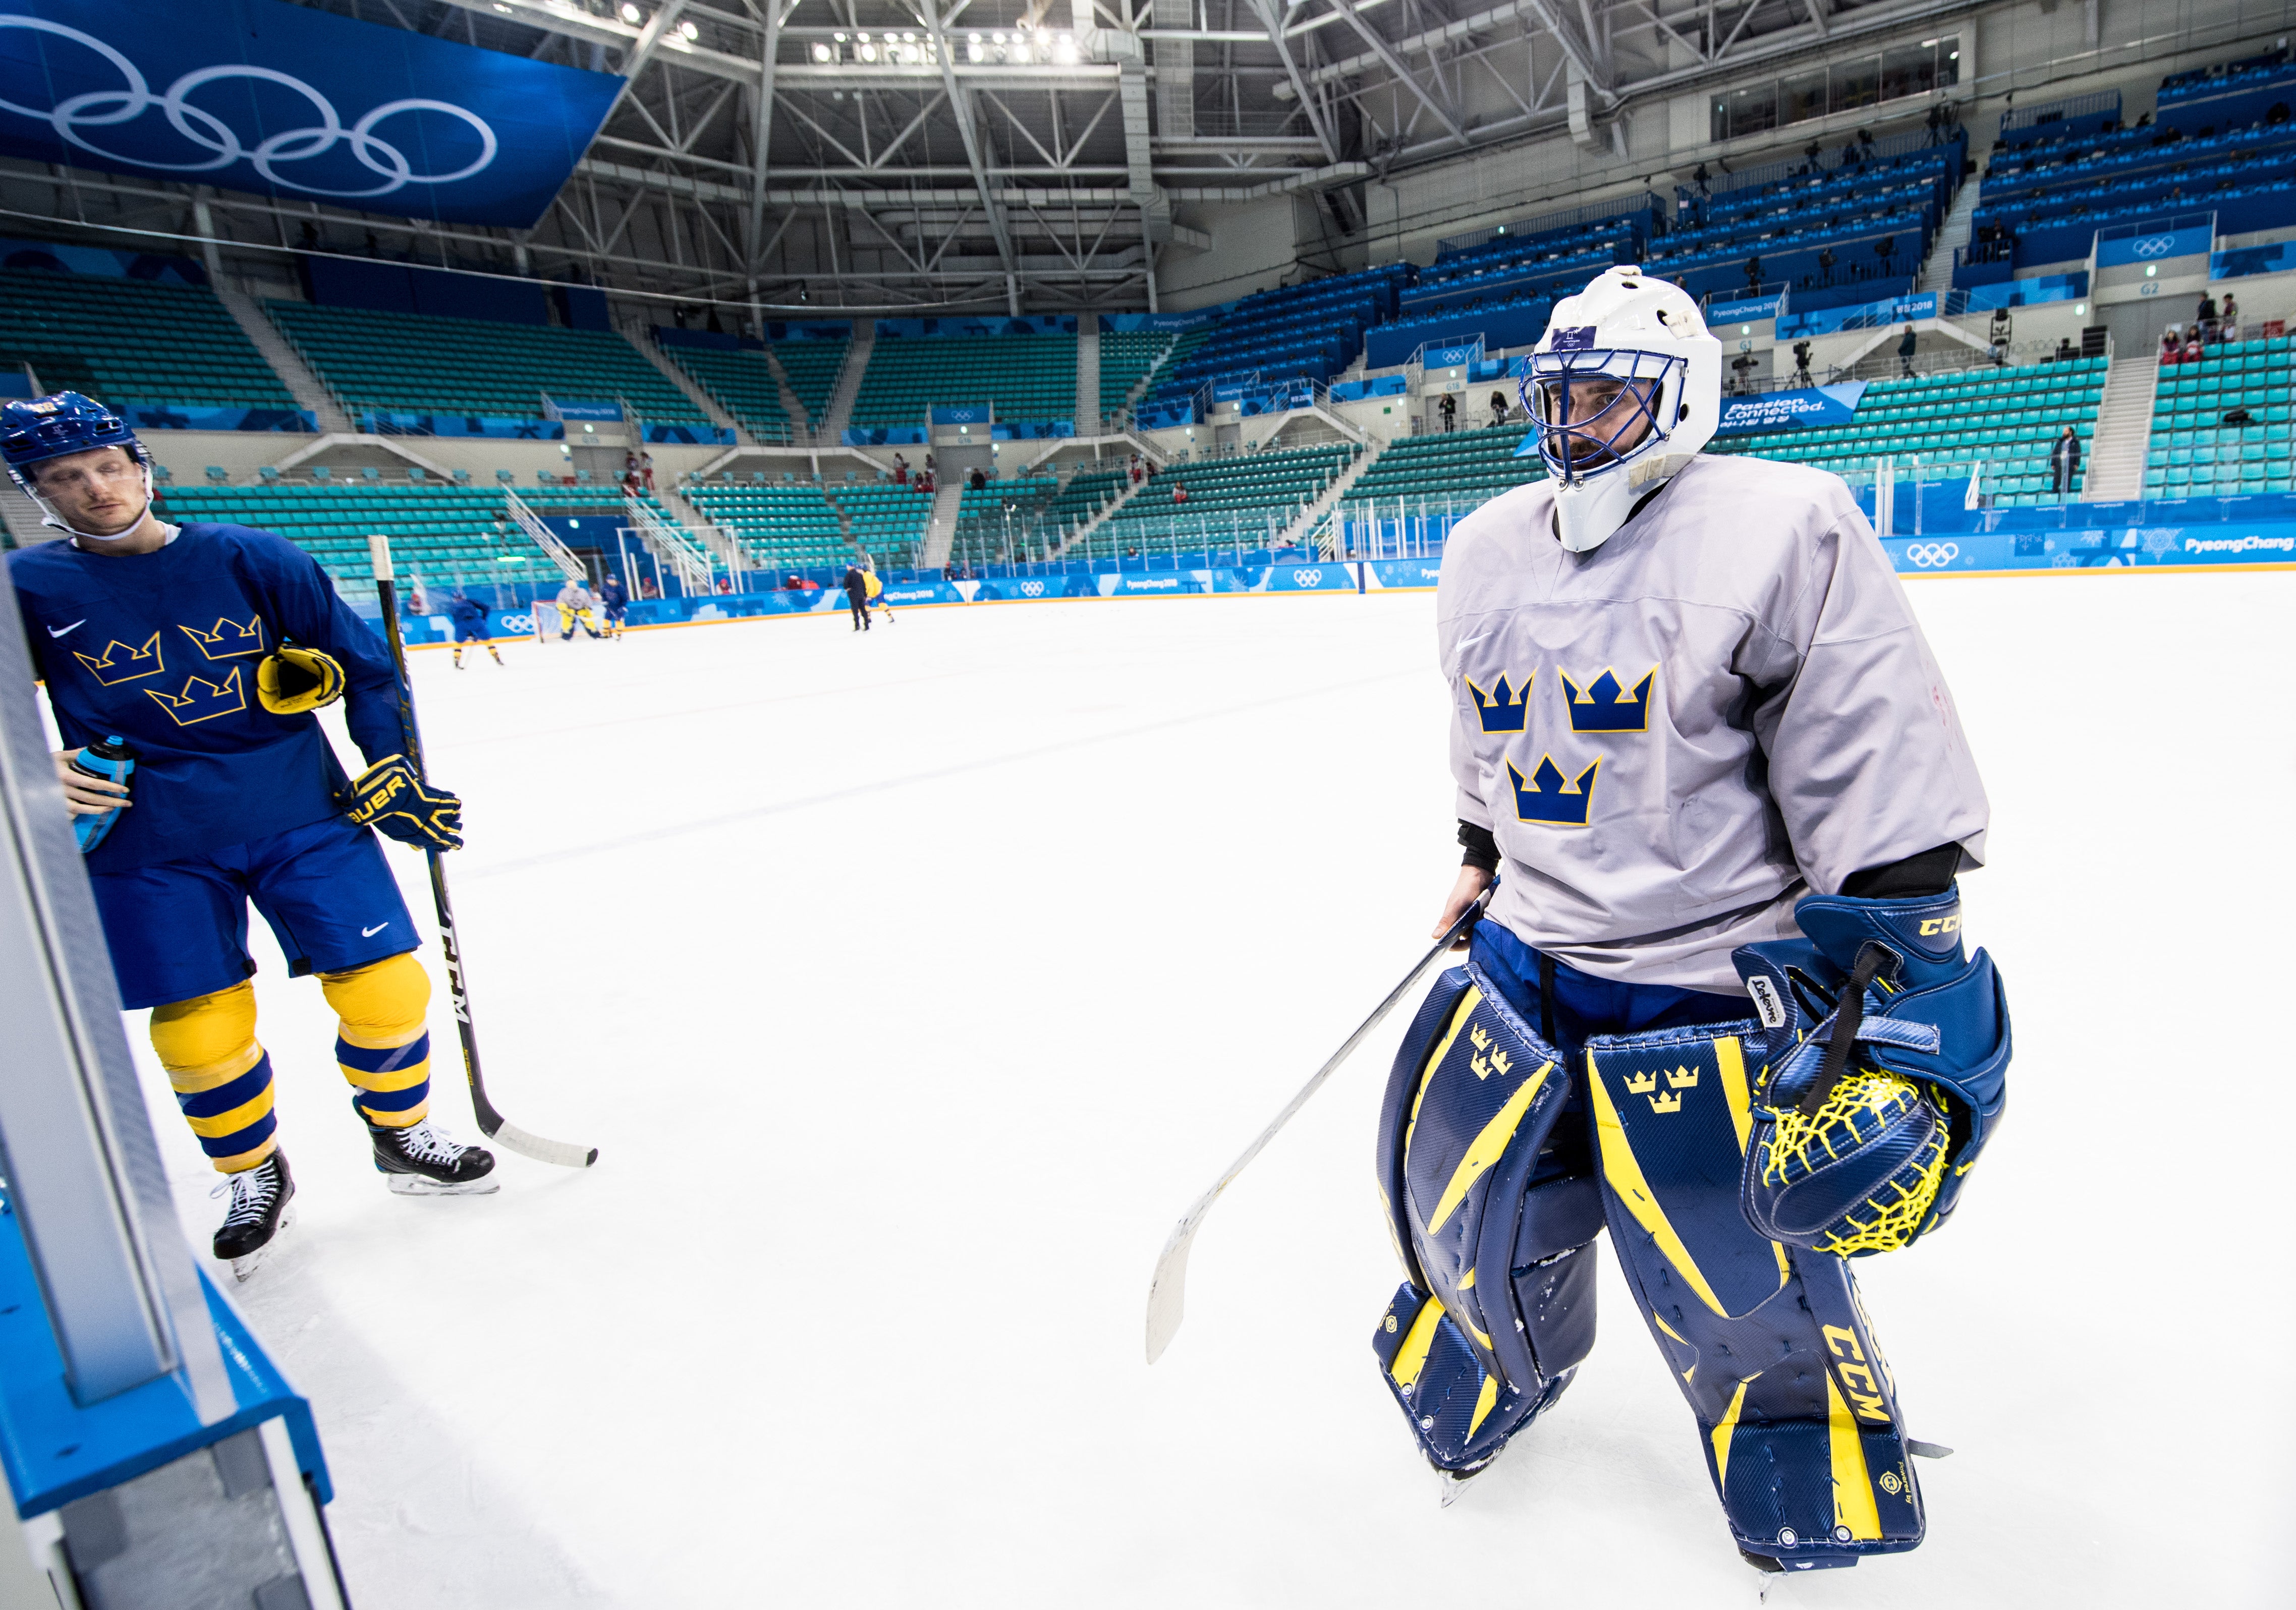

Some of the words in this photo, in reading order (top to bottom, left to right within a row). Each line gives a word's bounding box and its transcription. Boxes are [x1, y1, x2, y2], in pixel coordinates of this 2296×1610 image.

[2140, 282, 2159, 296] G2
[1713, 305, 1762, 318] PyeongChang
[1912, 300, 1933, 311] 2018
[1724, 401, 1825, 420] Connected.
[1729, 398, 1808, 412] Passion.
[2185, 536, 2294, 554] PyeongChang
[1127, 580, 1164, 590] PyeongChang
[1164, 578, 1178, 588] 2018
[916, 590, 934, 599] 2018
[1822, 1324, 1891, 1422] CCM
[1897, 1461, 1912, 1493] Powered
[1905, 1494, 1912, 1504] by
